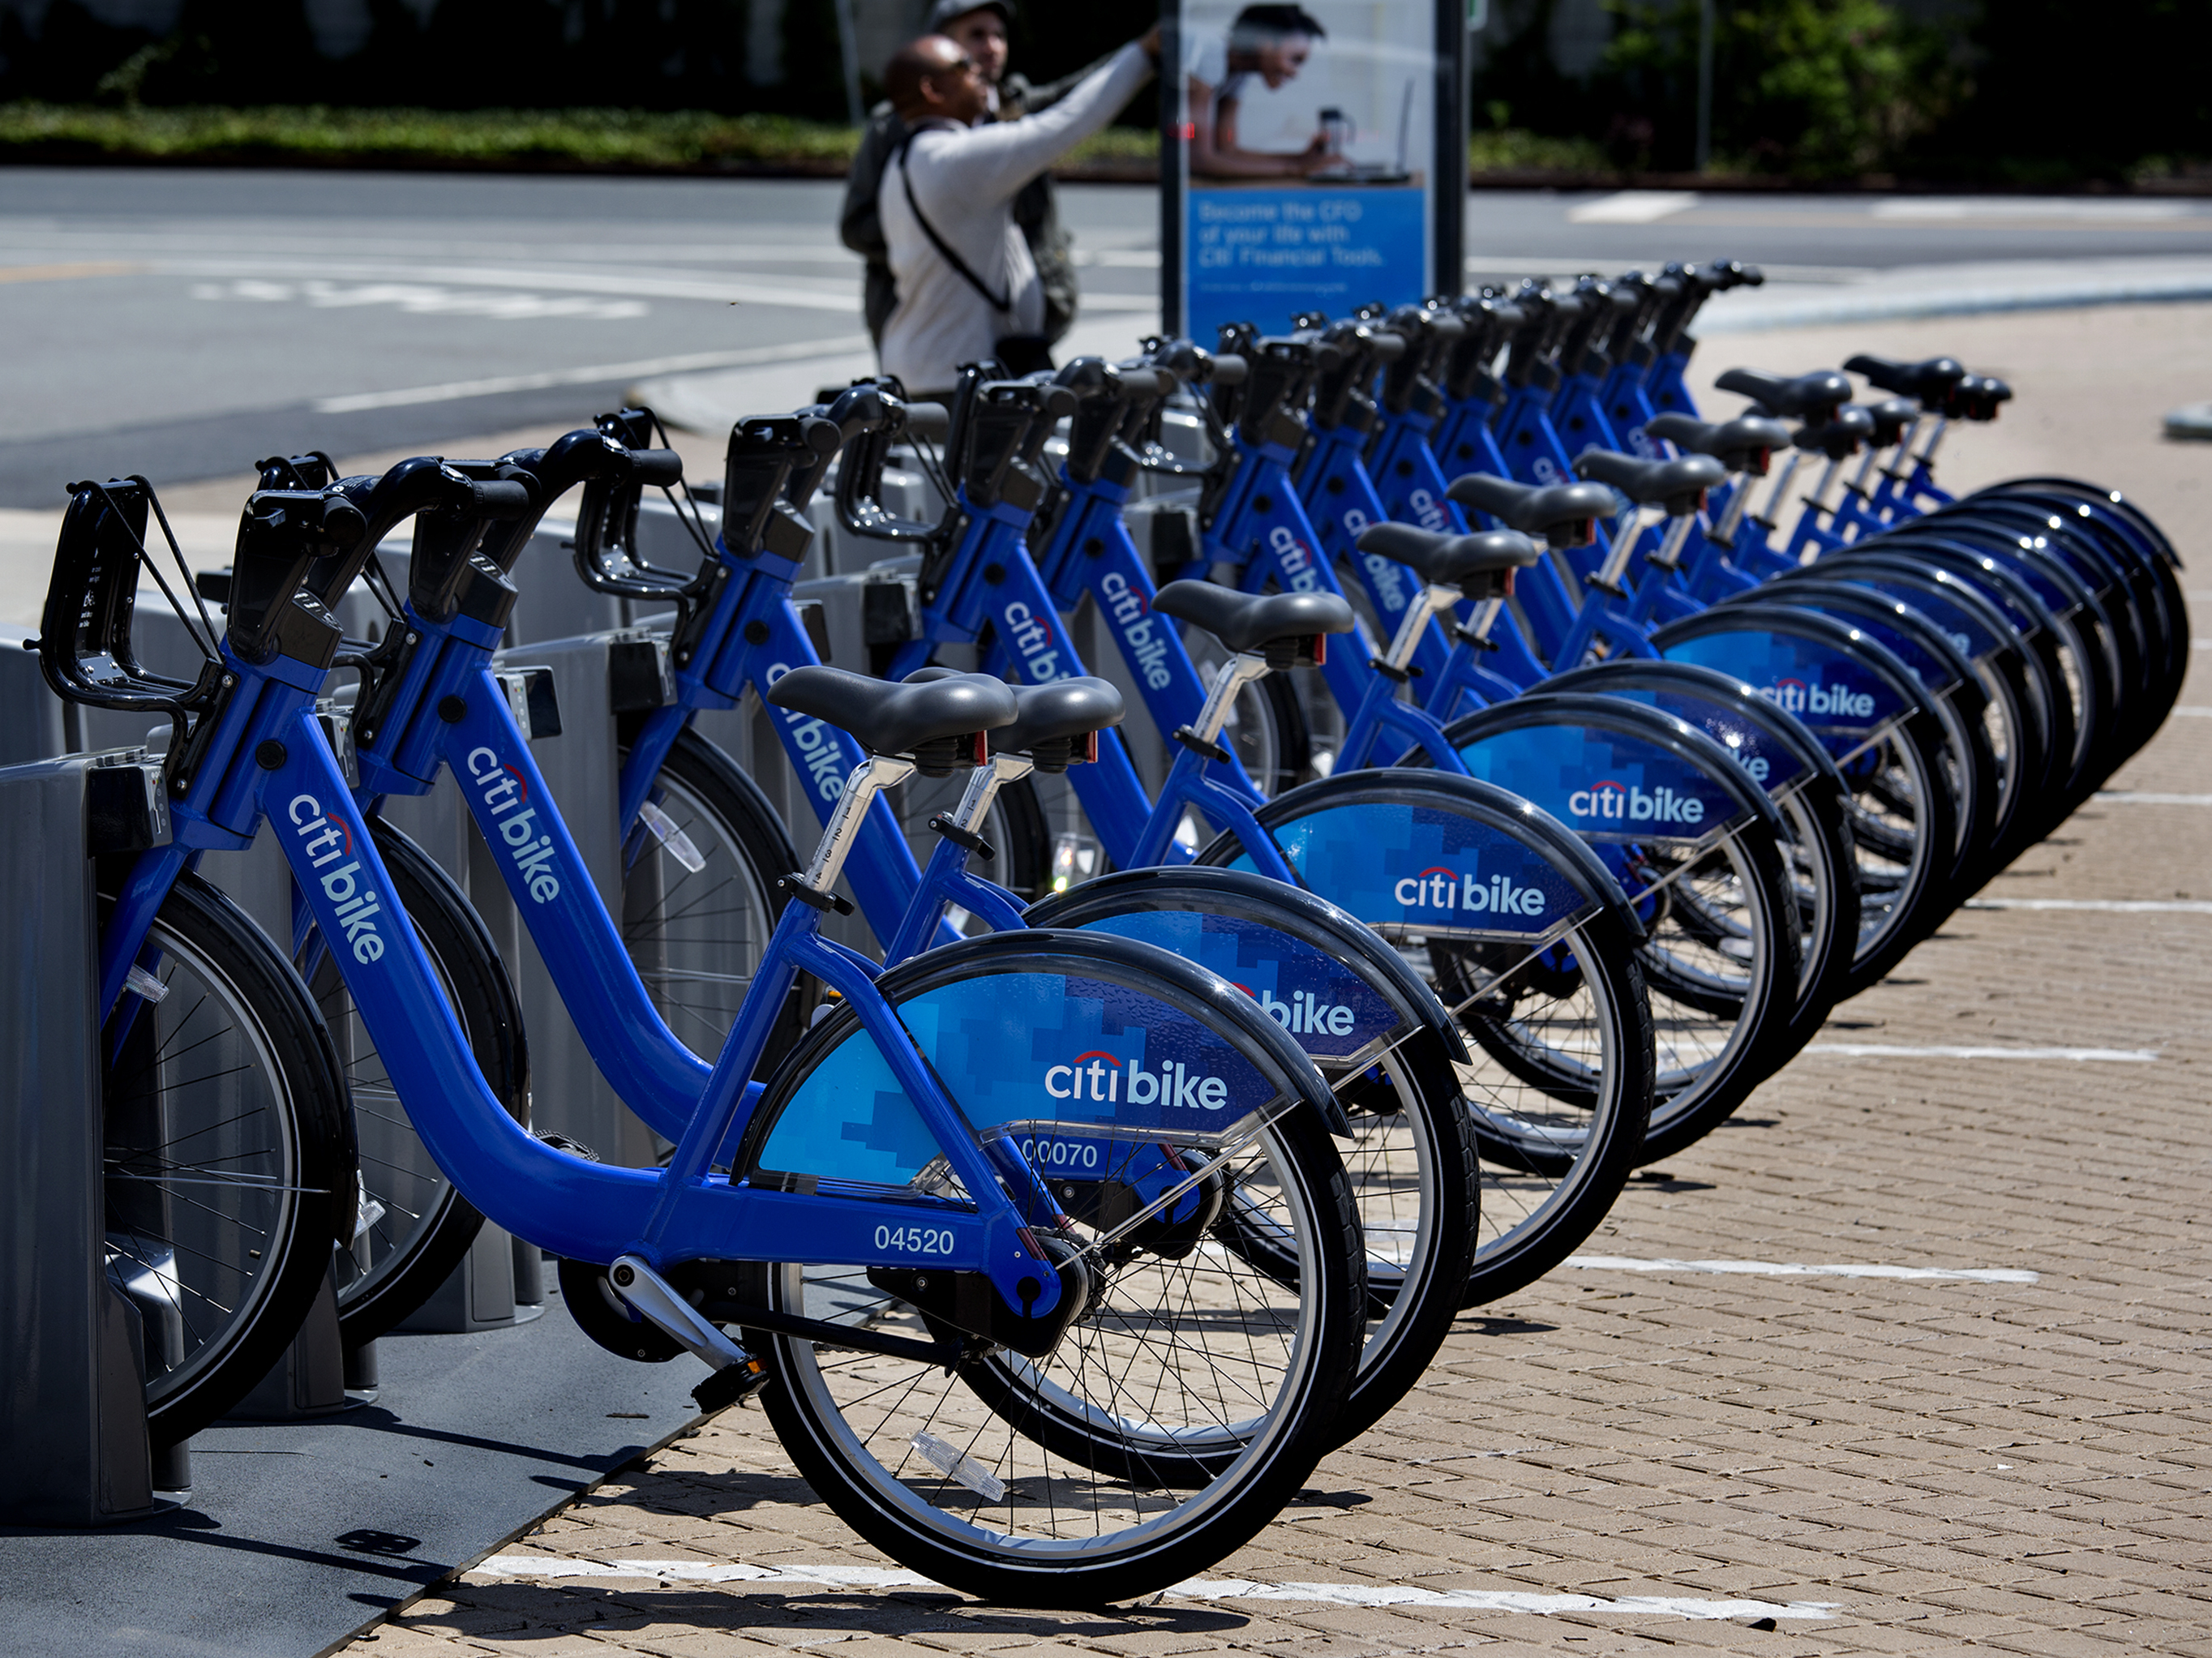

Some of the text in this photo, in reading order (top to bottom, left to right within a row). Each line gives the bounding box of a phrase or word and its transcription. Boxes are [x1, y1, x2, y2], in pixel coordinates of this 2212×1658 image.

[1198, 199, 1363, 223] Become the CFO
[1198, 225, 1350, 248] of your life with
[1239, 246, 1327, 267] Financial
[1005, 602, 1052, 657] citi
[1101, 572, 1171, 691] citi bike
[1809, 683, 1875, 718] bike
[792, 718, 845, 802] bike
[1569, 780, 1704, 824] citi bike
[467, 747, 560, 904] citi bike
[289, 794, 384, 965] citi bike
[1395, 867, 1545, 916] citi bike
[1262, 990, 1354, 1036] bike
[1045, 1051, 1228, 1110] citi bike
[1022, 1138, 1097, 1167] 00070
[874, 1225, 954, 1254] 04520
